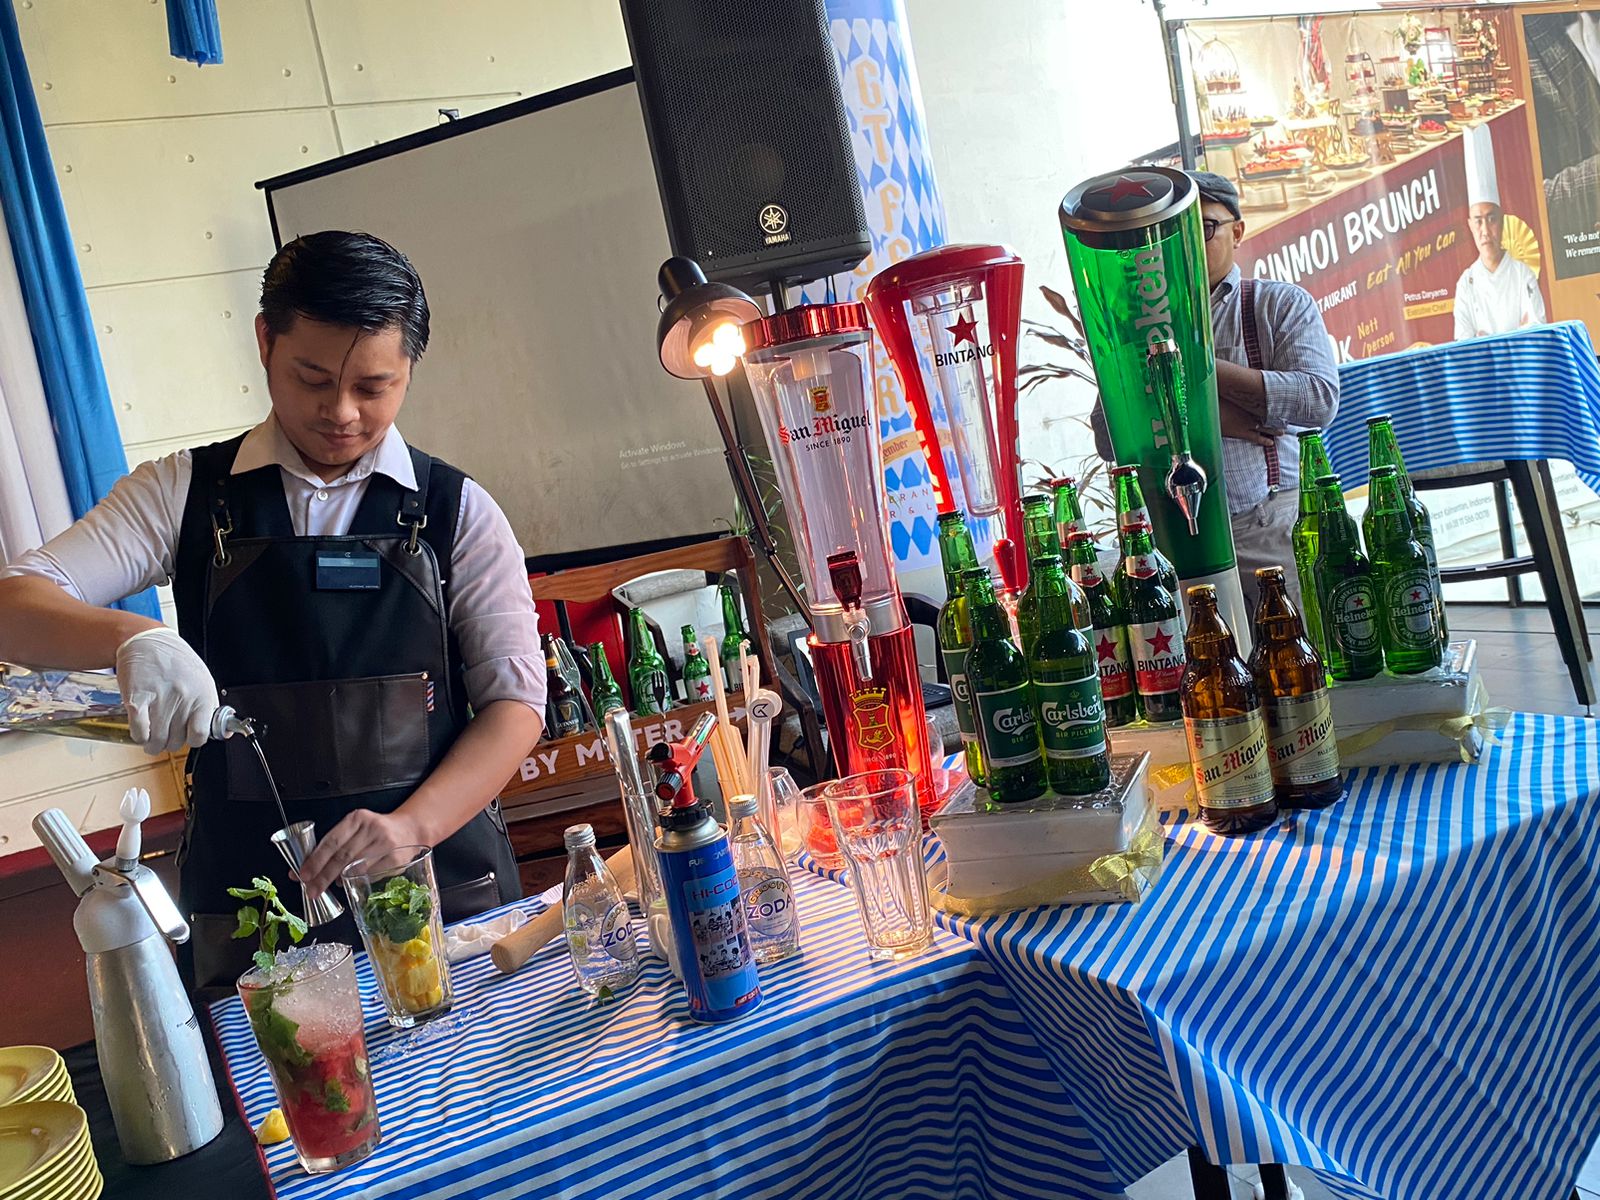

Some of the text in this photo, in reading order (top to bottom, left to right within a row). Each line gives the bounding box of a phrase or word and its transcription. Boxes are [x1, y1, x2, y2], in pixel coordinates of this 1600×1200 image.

[1343, 169, 1441, 254] BRUNCH
[765, 233, 790, 245] YAMAHA
[1579, 232, 1588, 242] do
[1588, 231, 1600, 240] not
[1367, 231, 1456, 290] Eat All You Can
[1565, 248, 1578, 258] We
[1316, 280, 1357, 314] TAURANT
[1357, 317, 1378, 339] Nett
[935, 343, 996, 367] BINTANG
[778, 410, 871, 446] San Miguel
[650, 441, 686, 452] Windows
[805, 436, 851, 451] SINCE 1890
[882, 439, 908, 458] ember
[1137, 654, 1185, 671] BINTANG
[520, 719, 685, 782] BY MTER
[1196, 765, 1221, 785] San
[1222, 729, 1266, 776] Miguel
[1269, 742, 1295, 763] San
[603, 921, 633, 948] ZOD
